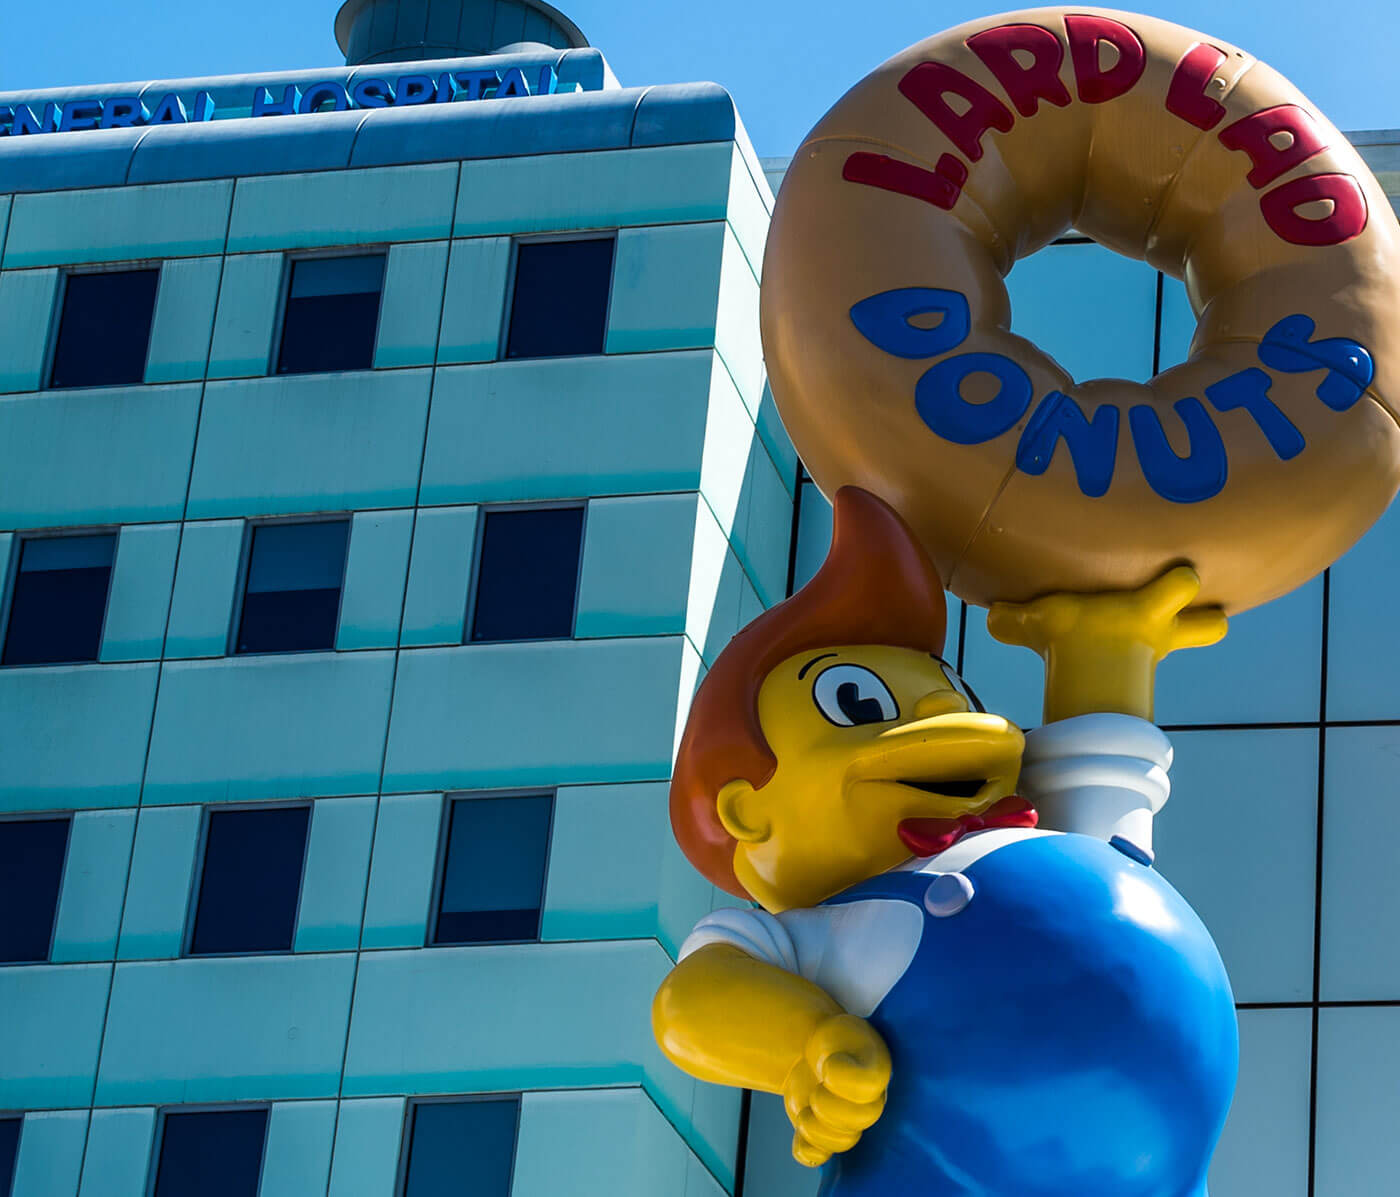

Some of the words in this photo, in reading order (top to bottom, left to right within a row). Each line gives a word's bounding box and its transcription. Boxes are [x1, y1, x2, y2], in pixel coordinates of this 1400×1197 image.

[0, 91, 213, 137] NERA
[842, 14, 1146, 210] LARD
[1166, 42, 1368, 246] LAD
[849, 287, 1375, 504] DONUTS
